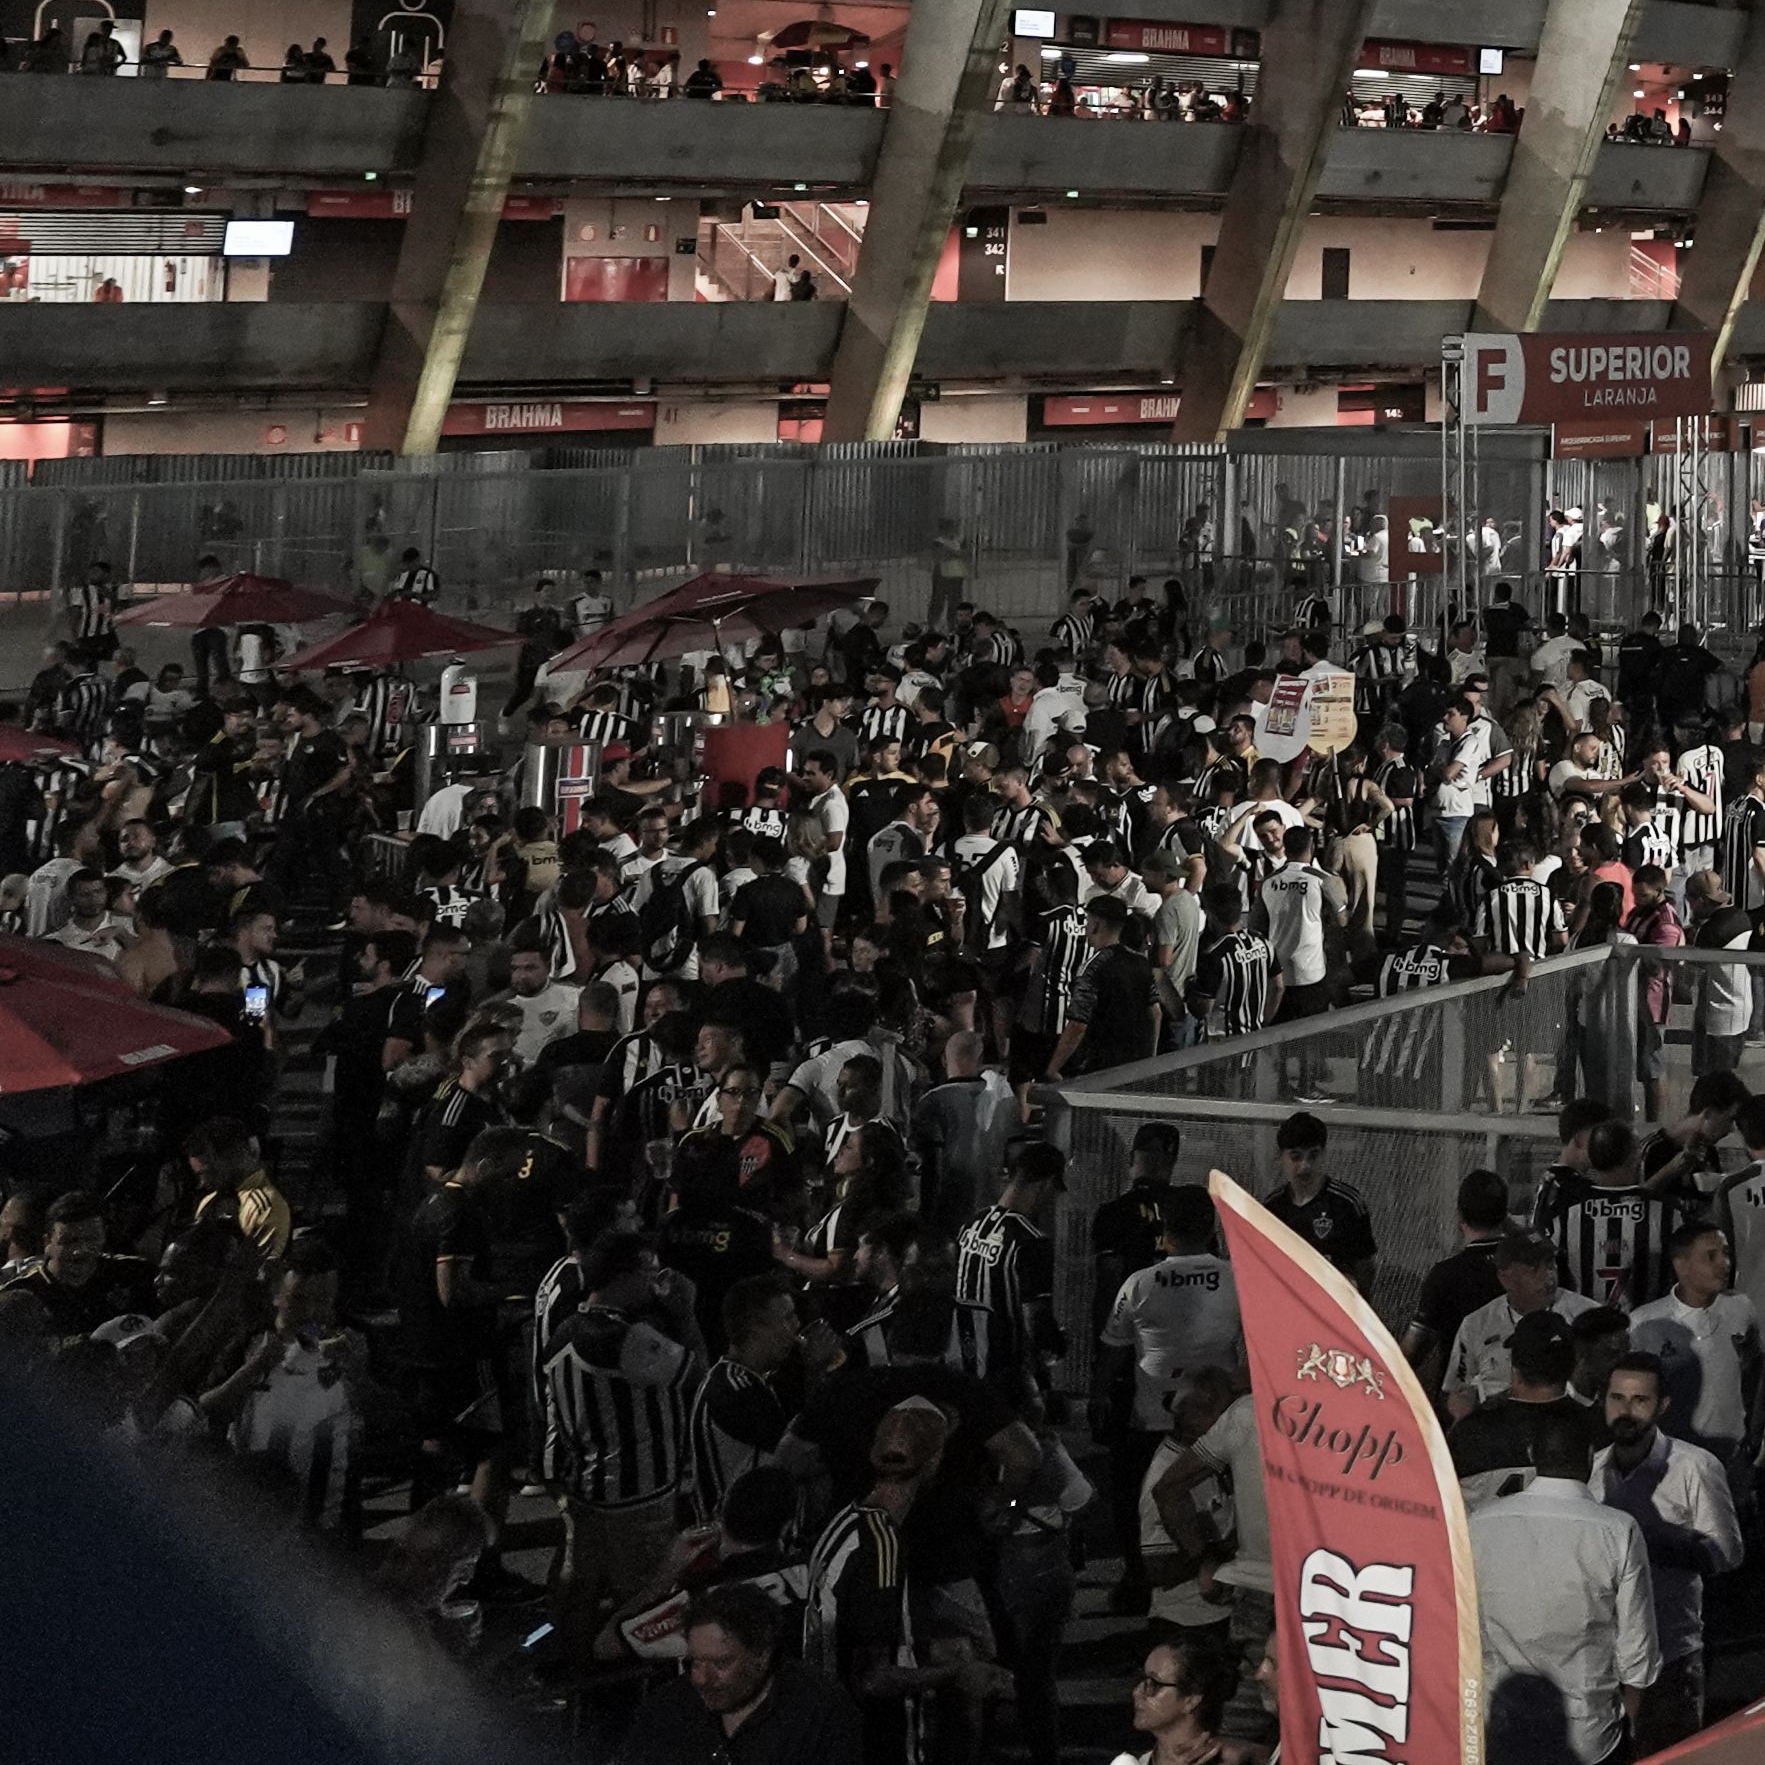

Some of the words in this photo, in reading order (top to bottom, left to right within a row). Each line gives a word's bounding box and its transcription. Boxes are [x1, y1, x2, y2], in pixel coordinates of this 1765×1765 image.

[1142, 27, 1190, 50] BRAHMA
[984, 244, 1005, 256] 342
[1550, 348, 1692, 384] SUPERIOR
[1476, 348, 1507, 413] F
[1583, 386, 1659, 408] LARANJA
[485, 403, 564, 430] BRAHMA
[754, 819, 783, 836] bmg
[532, 856, 556, 865] bm
[1281, 880, 1309, 895] bmg
[1511, 882, 1540, 897] bmg
[1412, 956, 1440, 979] bmg
[1600, 1200, 1643, 1221] bmg
[971, 1238, 1000, 1266] bmg
[1170, 1271, 1220, 1291] bmg
[1272, 1395, 1408, 1482] Chopp
[1342, 1487, 1367, 1502] DE
[1370, 1492, 1438, 1519] ORIGEM
